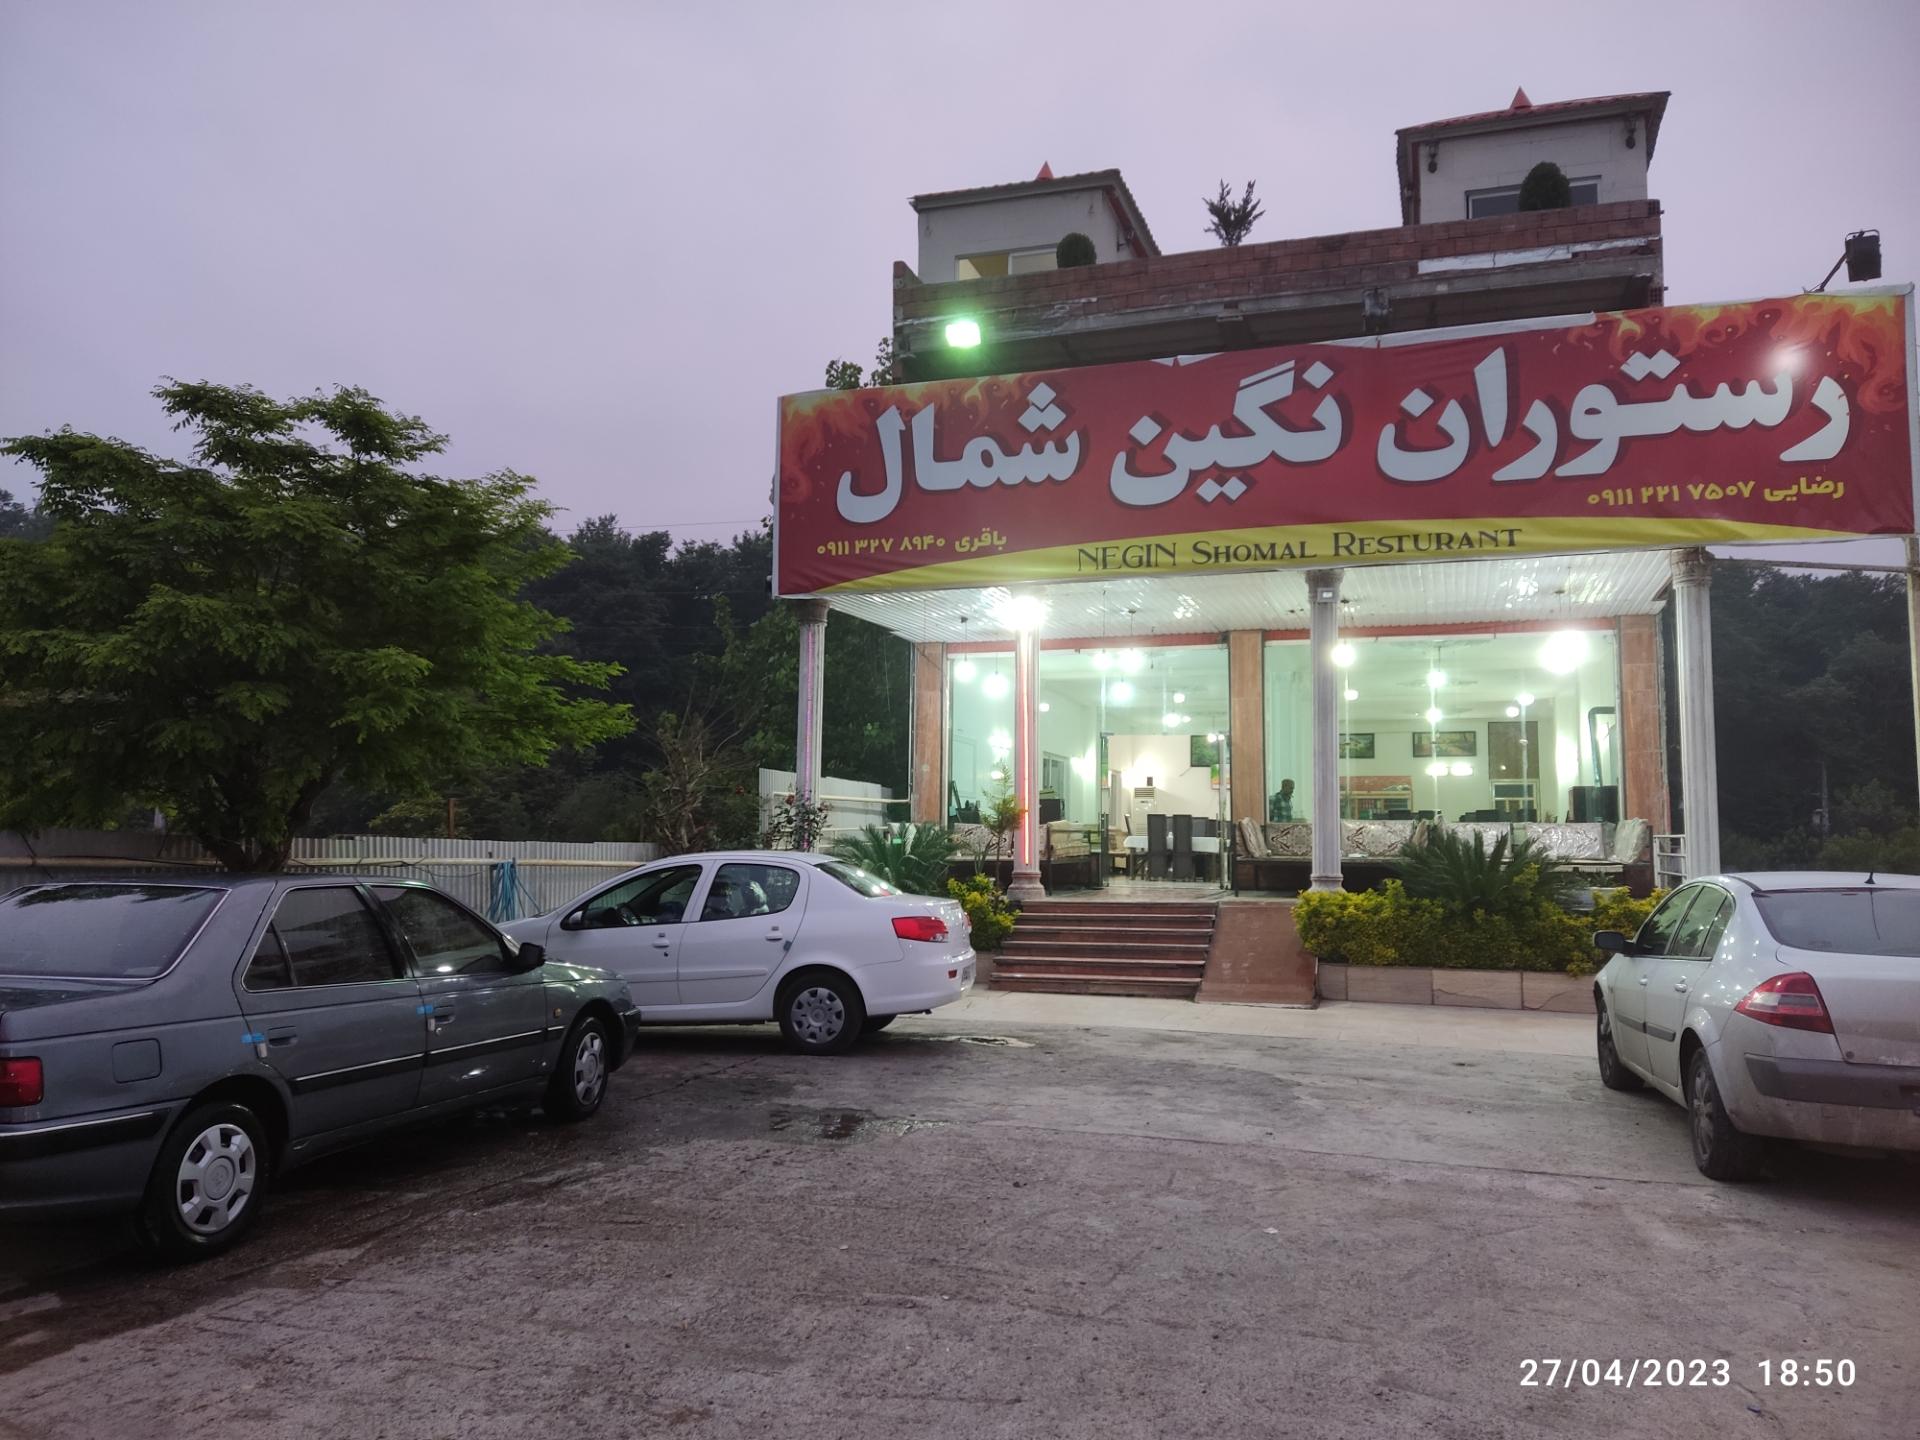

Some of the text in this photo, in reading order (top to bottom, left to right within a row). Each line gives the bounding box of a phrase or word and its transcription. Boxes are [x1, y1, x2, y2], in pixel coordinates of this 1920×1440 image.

[836, 346, 1851, 523] رستوران نگین شمال
[1587, 487, 1634, 506] ۰۹۱۱
[1687, 480, 1755, 501] ۷۵۰۷
[1764, 475, 1844, 502] رضایی
[816, 527, 1007, 557] باقری ۰۹۱۱ ۳۲۷ ۸۹۴۰
[1077, 542, 1177, 571] NEGIN
